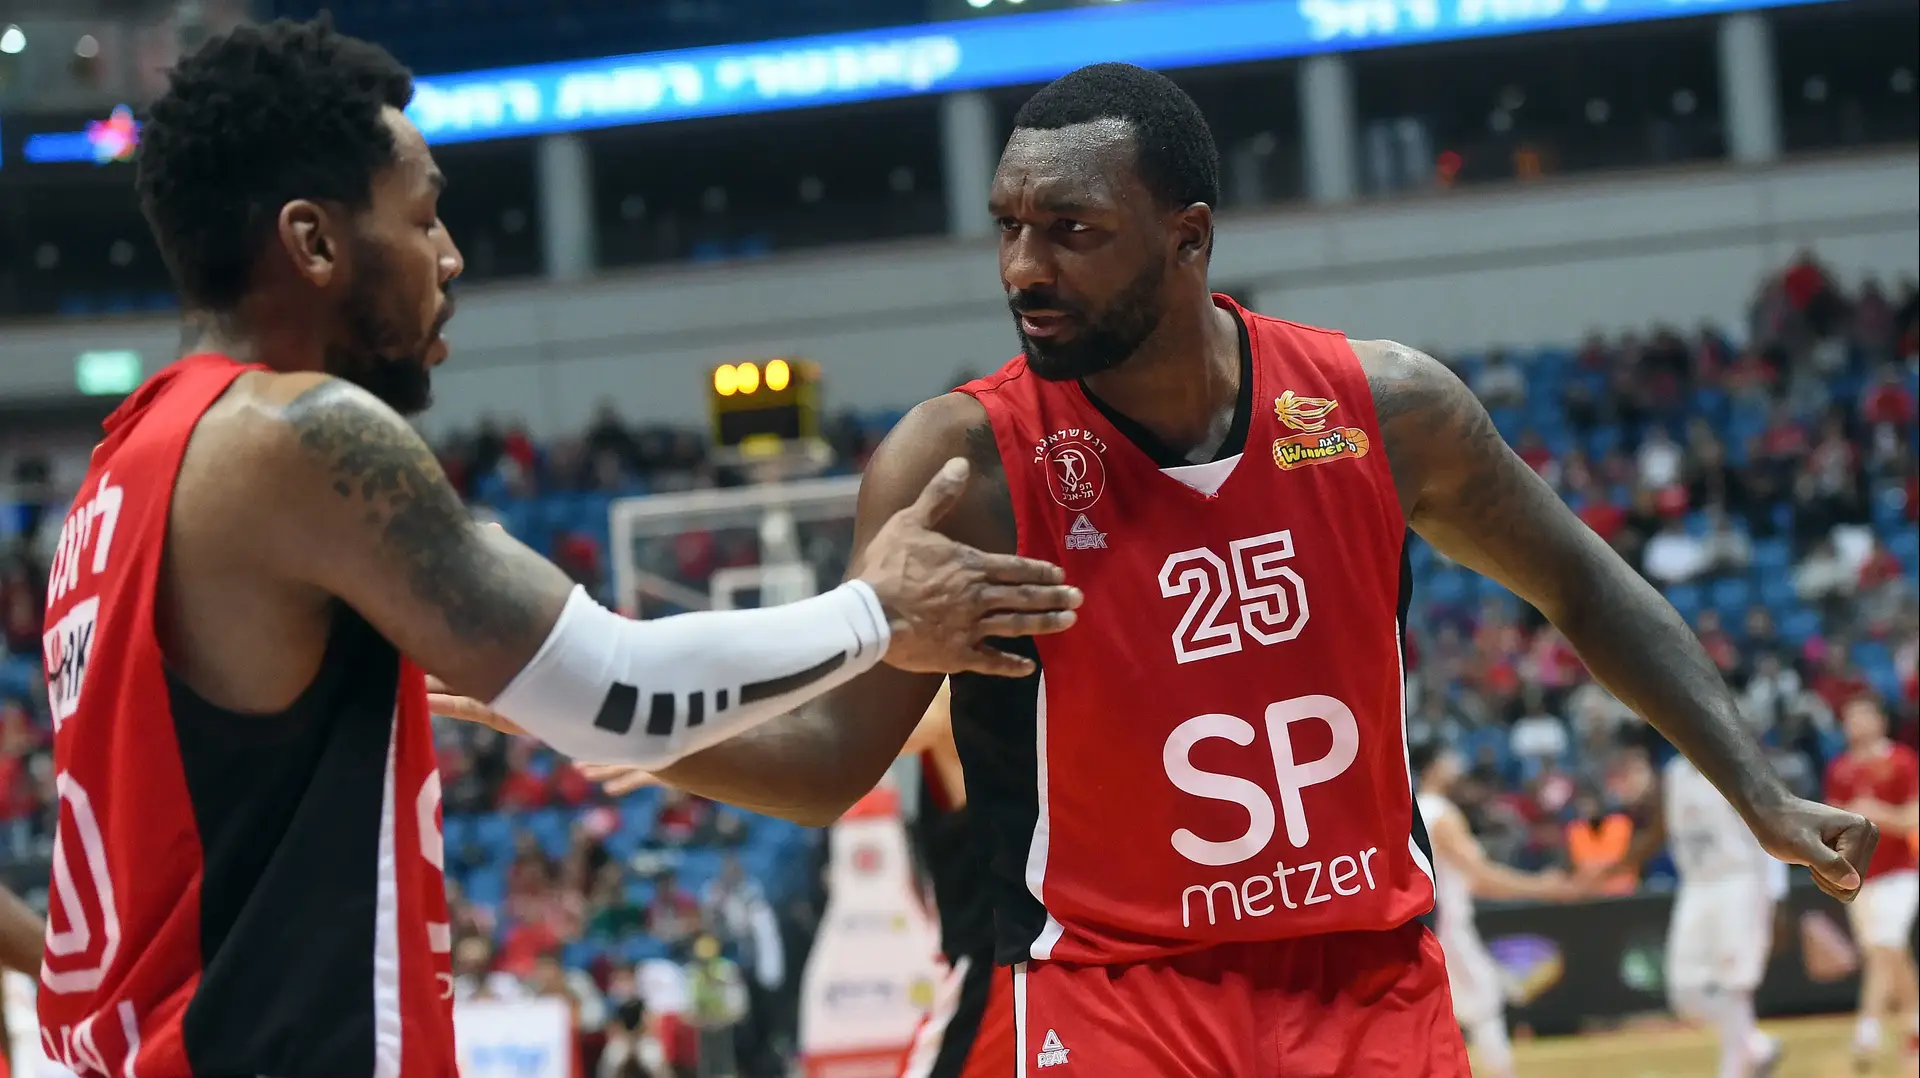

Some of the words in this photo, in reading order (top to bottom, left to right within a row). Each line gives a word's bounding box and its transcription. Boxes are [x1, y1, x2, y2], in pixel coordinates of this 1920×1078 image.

[1065, 532, 1108, 550] PEAK
[1157, 529, 1310, 664] 25
[1163, 694, 1359, 865] SP
[1182, 847, 1377, 928] metzer
[1037, 1048, 1070, 1069] PEAK
